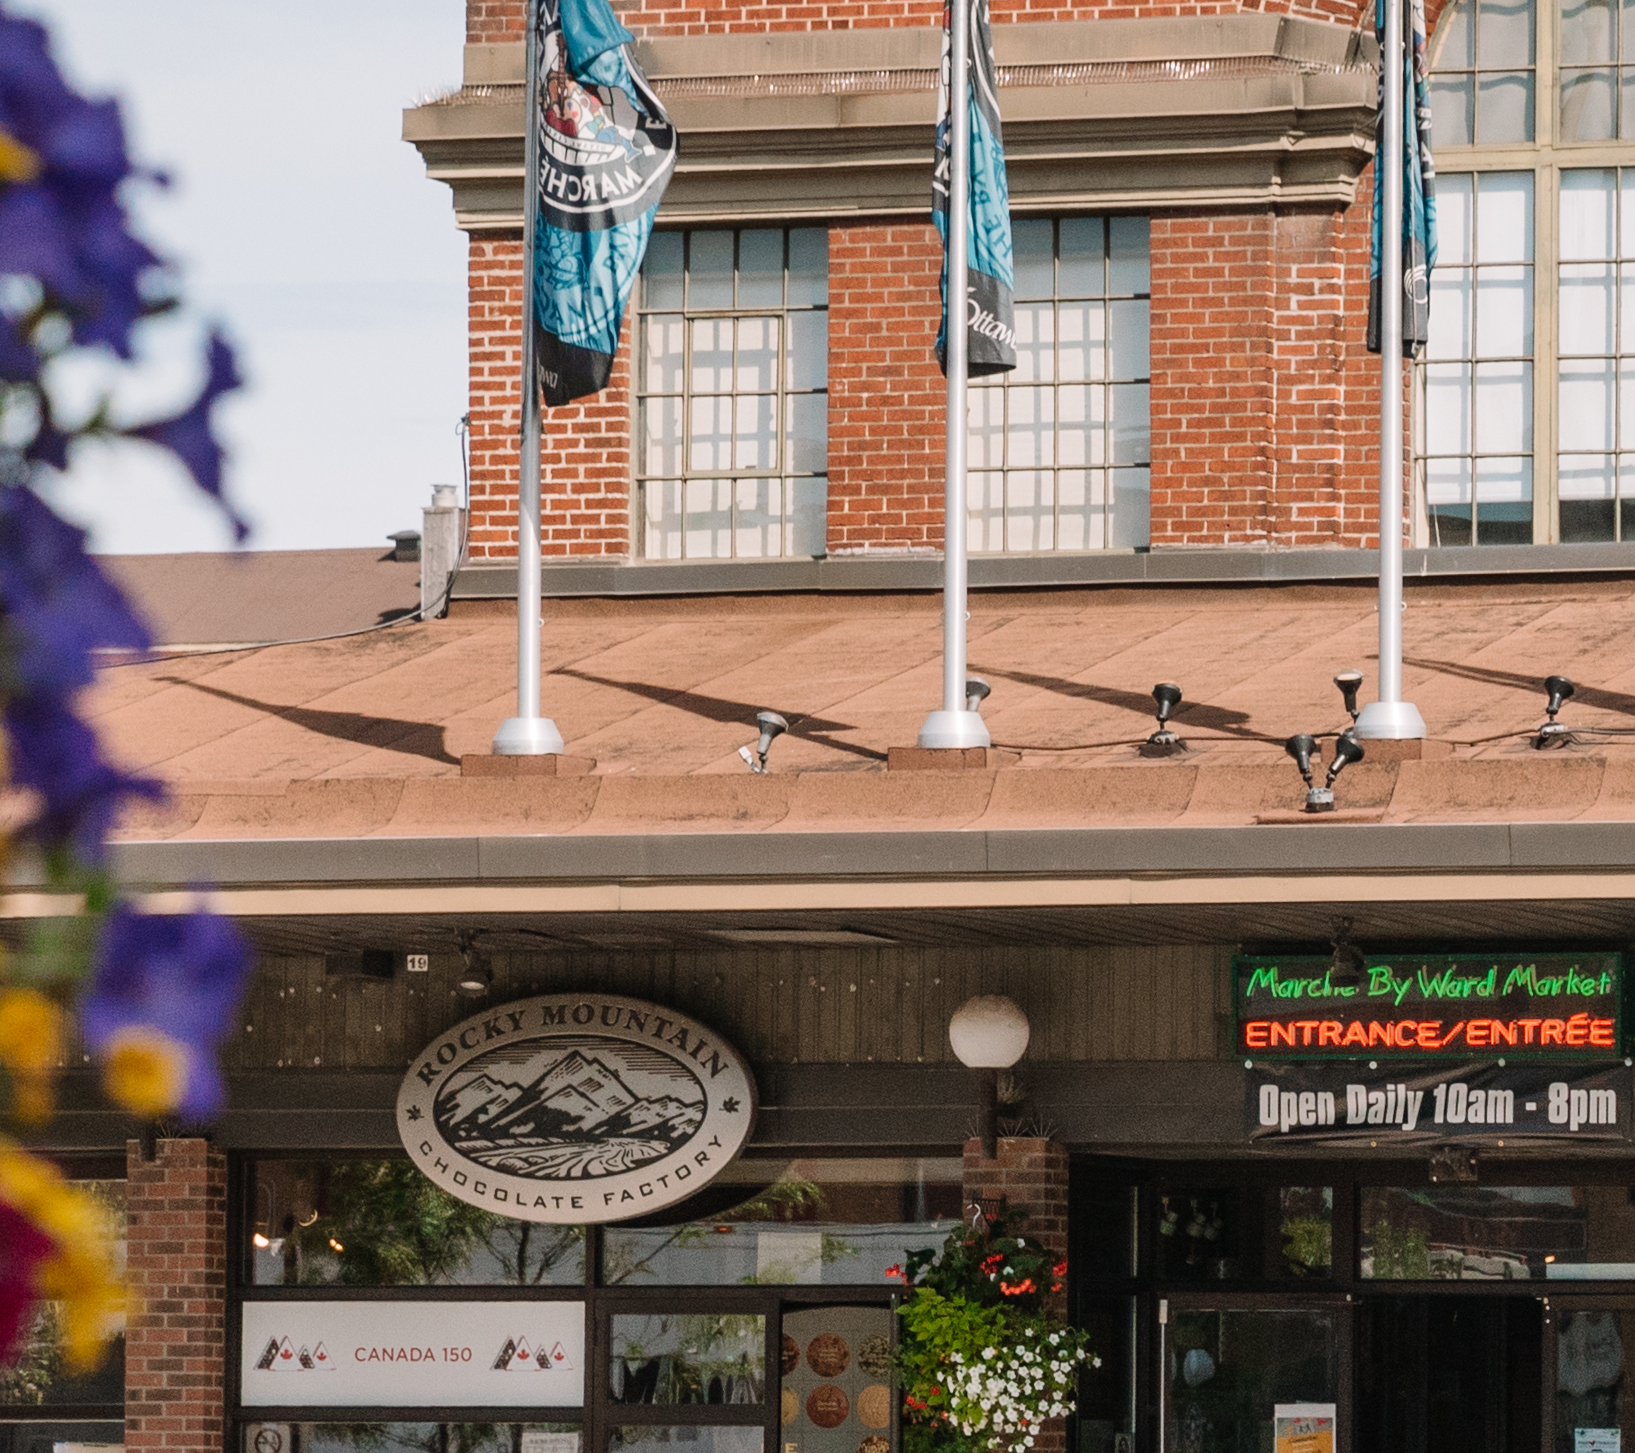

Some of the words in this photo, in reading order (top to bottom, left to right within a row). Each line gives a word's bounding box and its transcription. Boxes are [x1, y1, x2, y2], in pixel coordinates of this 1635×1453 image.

[408, 956, 428, 971] 19
[1367, 966, 1411, 1006] By
[1416, 965, 1498, 999] Ward
[1502, 965, 1611, 998] Market
[417, 1009, 526, 1087] ROCKY
[541, 1002, 729, 1079] MOUNTAIN
[1245, 1012, 1616, 1049] ENTRANCE/ENTRÉE
[1259, 1085, 1336, 1133] Open
[1346, 1084, 1424, 1131] Daily
[1433, 1082, 1514, 1125] 10am
[1525, 1101, 1537, 1111] -
[1547, 1082, 1617, 1132] 8pm
[419, 1140, 585, 1209] CHOCOLATE
[604, 1134, 723, 1206] FACTORY
[354, 1347, 436, 1362] CANADA
[442, 1347, 473, 1362] 150
